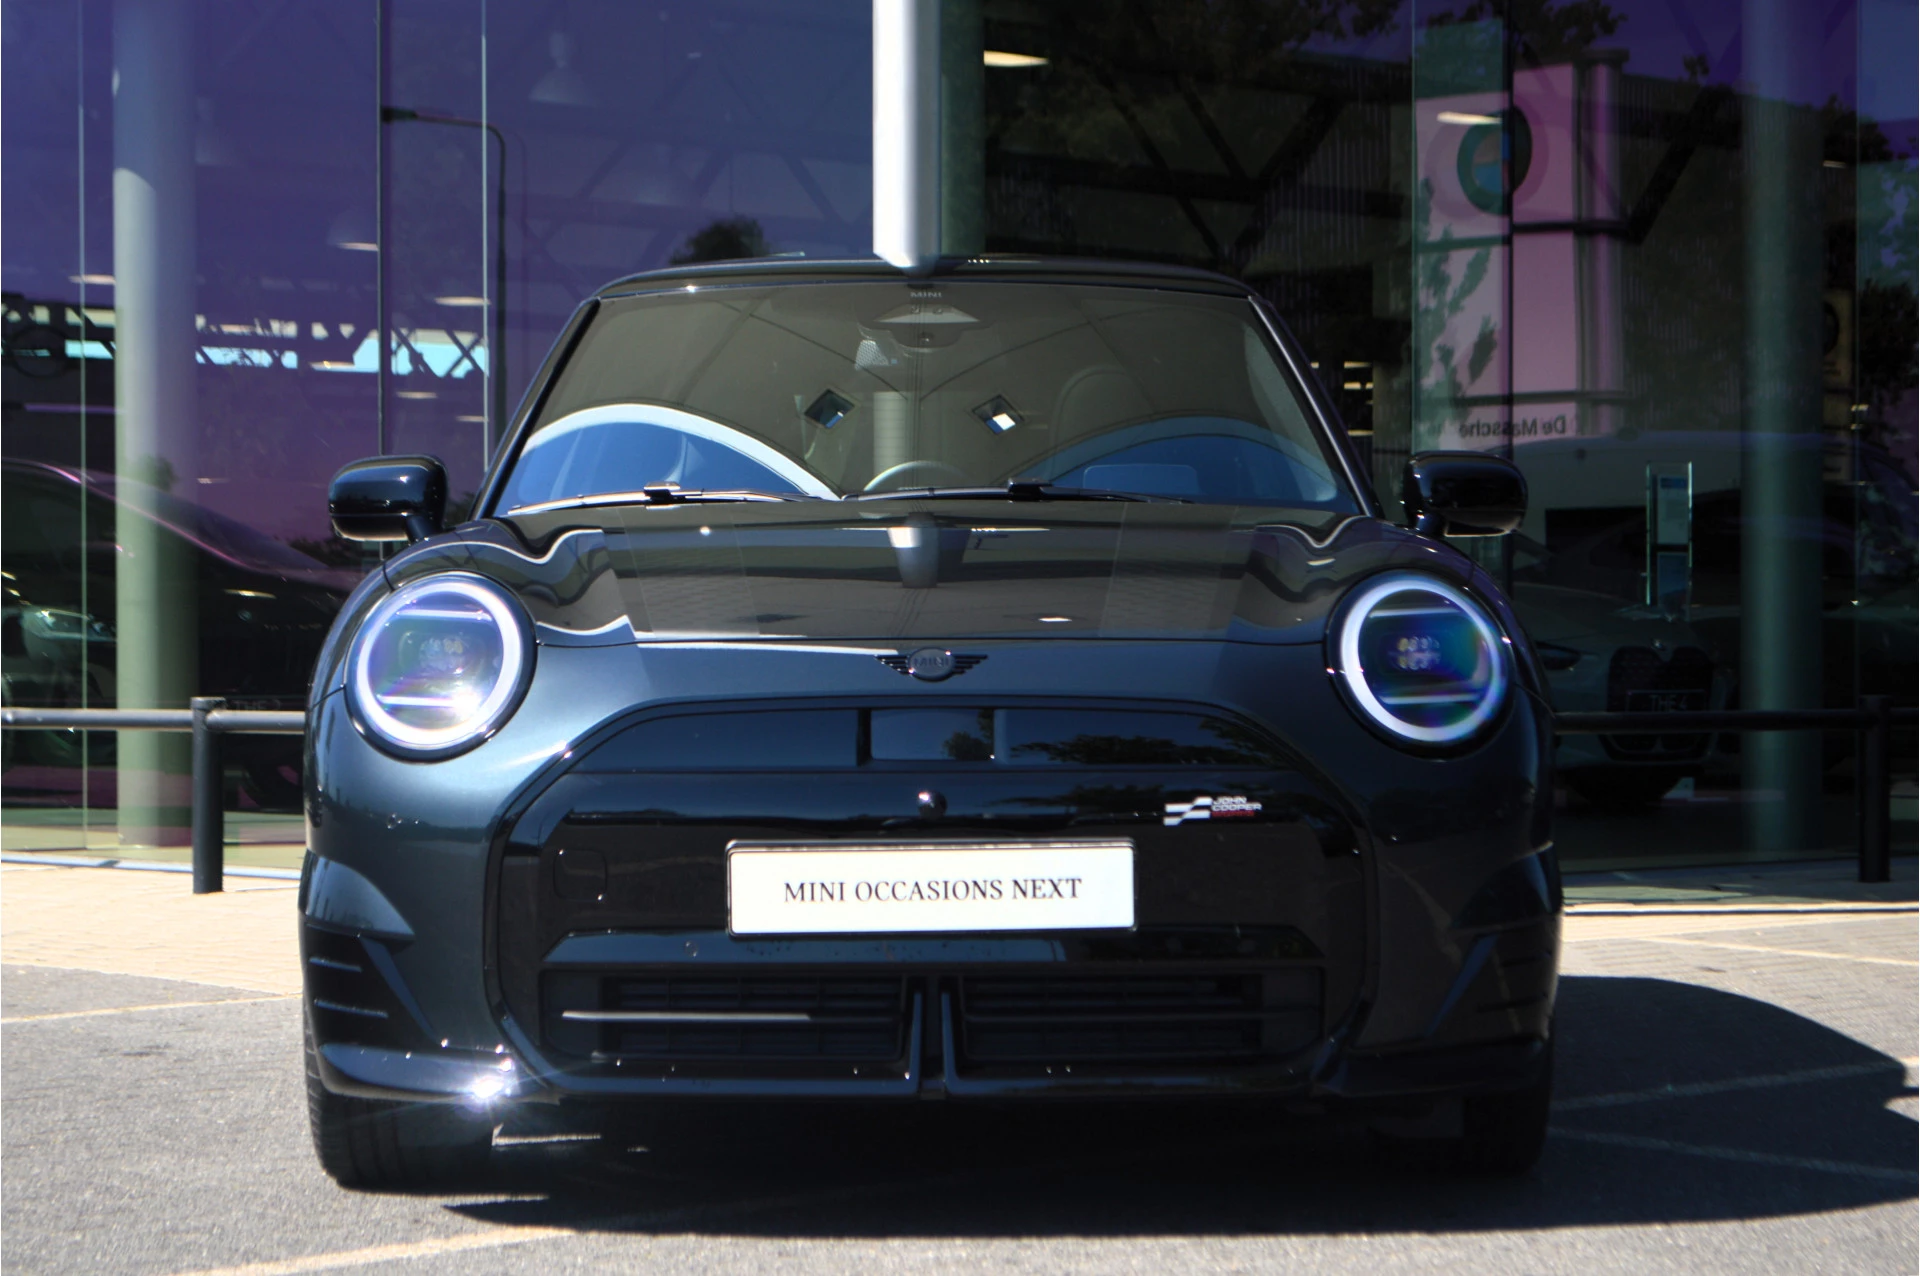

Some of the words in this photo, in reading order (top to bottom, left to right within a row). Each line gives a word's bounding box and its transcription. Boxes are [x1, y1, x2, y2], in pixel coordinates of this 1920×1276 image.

[1213, 796, 1247, 805] JOHN
[1212, 803, 1262, 811] COOPER
[784, 881, 846, 903] MINI
[855, 880, 1003, 902] OCCASIONS
[1011, 878, 1082, 900] NEXT
